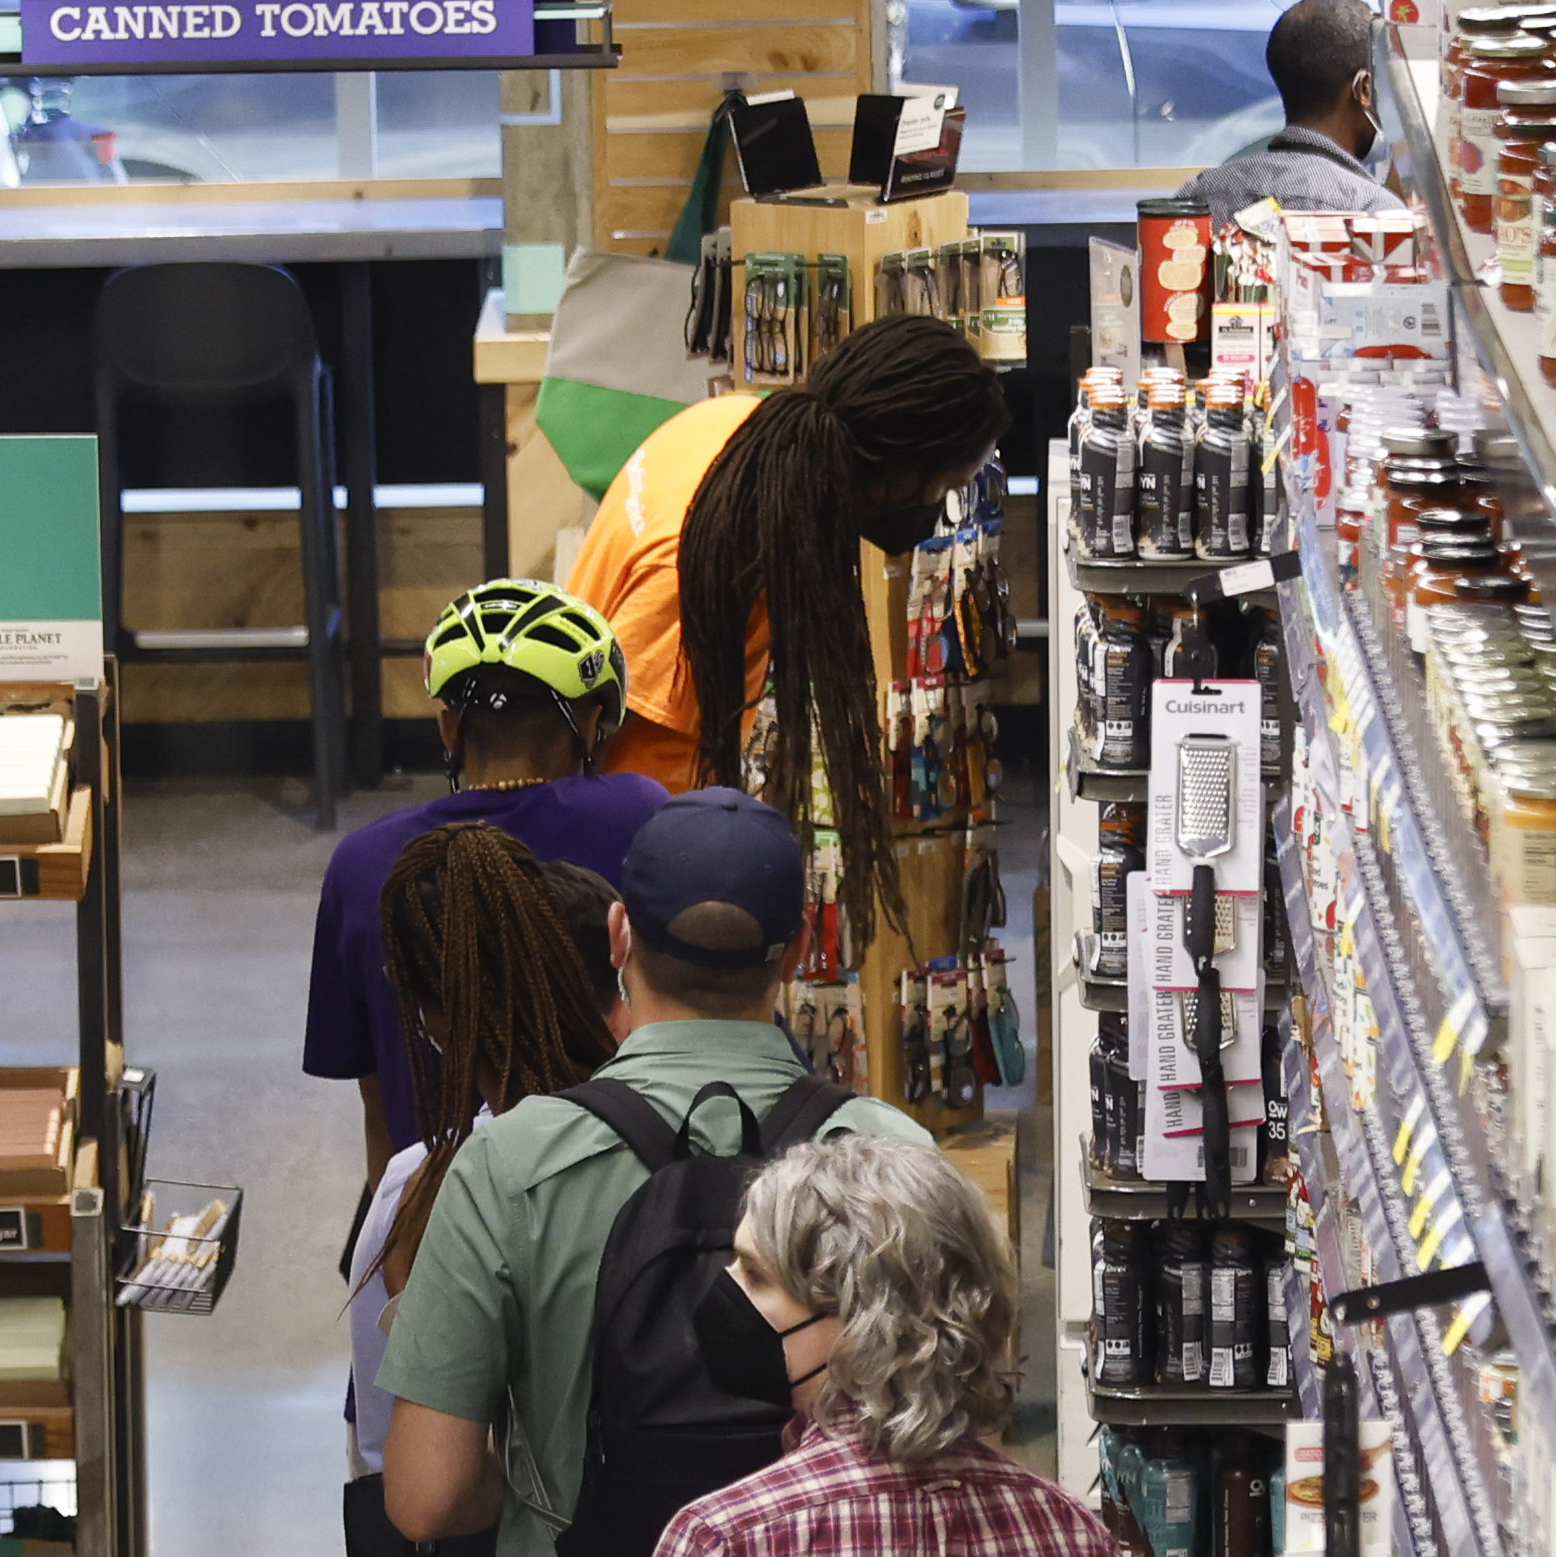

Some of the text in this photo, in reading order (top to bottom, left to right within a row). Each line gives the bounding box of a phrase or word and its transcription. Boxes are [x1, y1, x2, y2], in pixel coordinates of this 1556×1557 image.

[50, 0, 498, 41] CANNED TOMATOES
[15, 632, 63, 645] PLANET
[1164, 699, 1246, 715] Cuisinart
[1155, 793, 1173, 886] HAND GRATER
[1155, 896, 1175, 982] HAND GRATE
[1159, 1047, 1177, 1082] HAND
[1164, 1089, 1183, 1128] HAND
